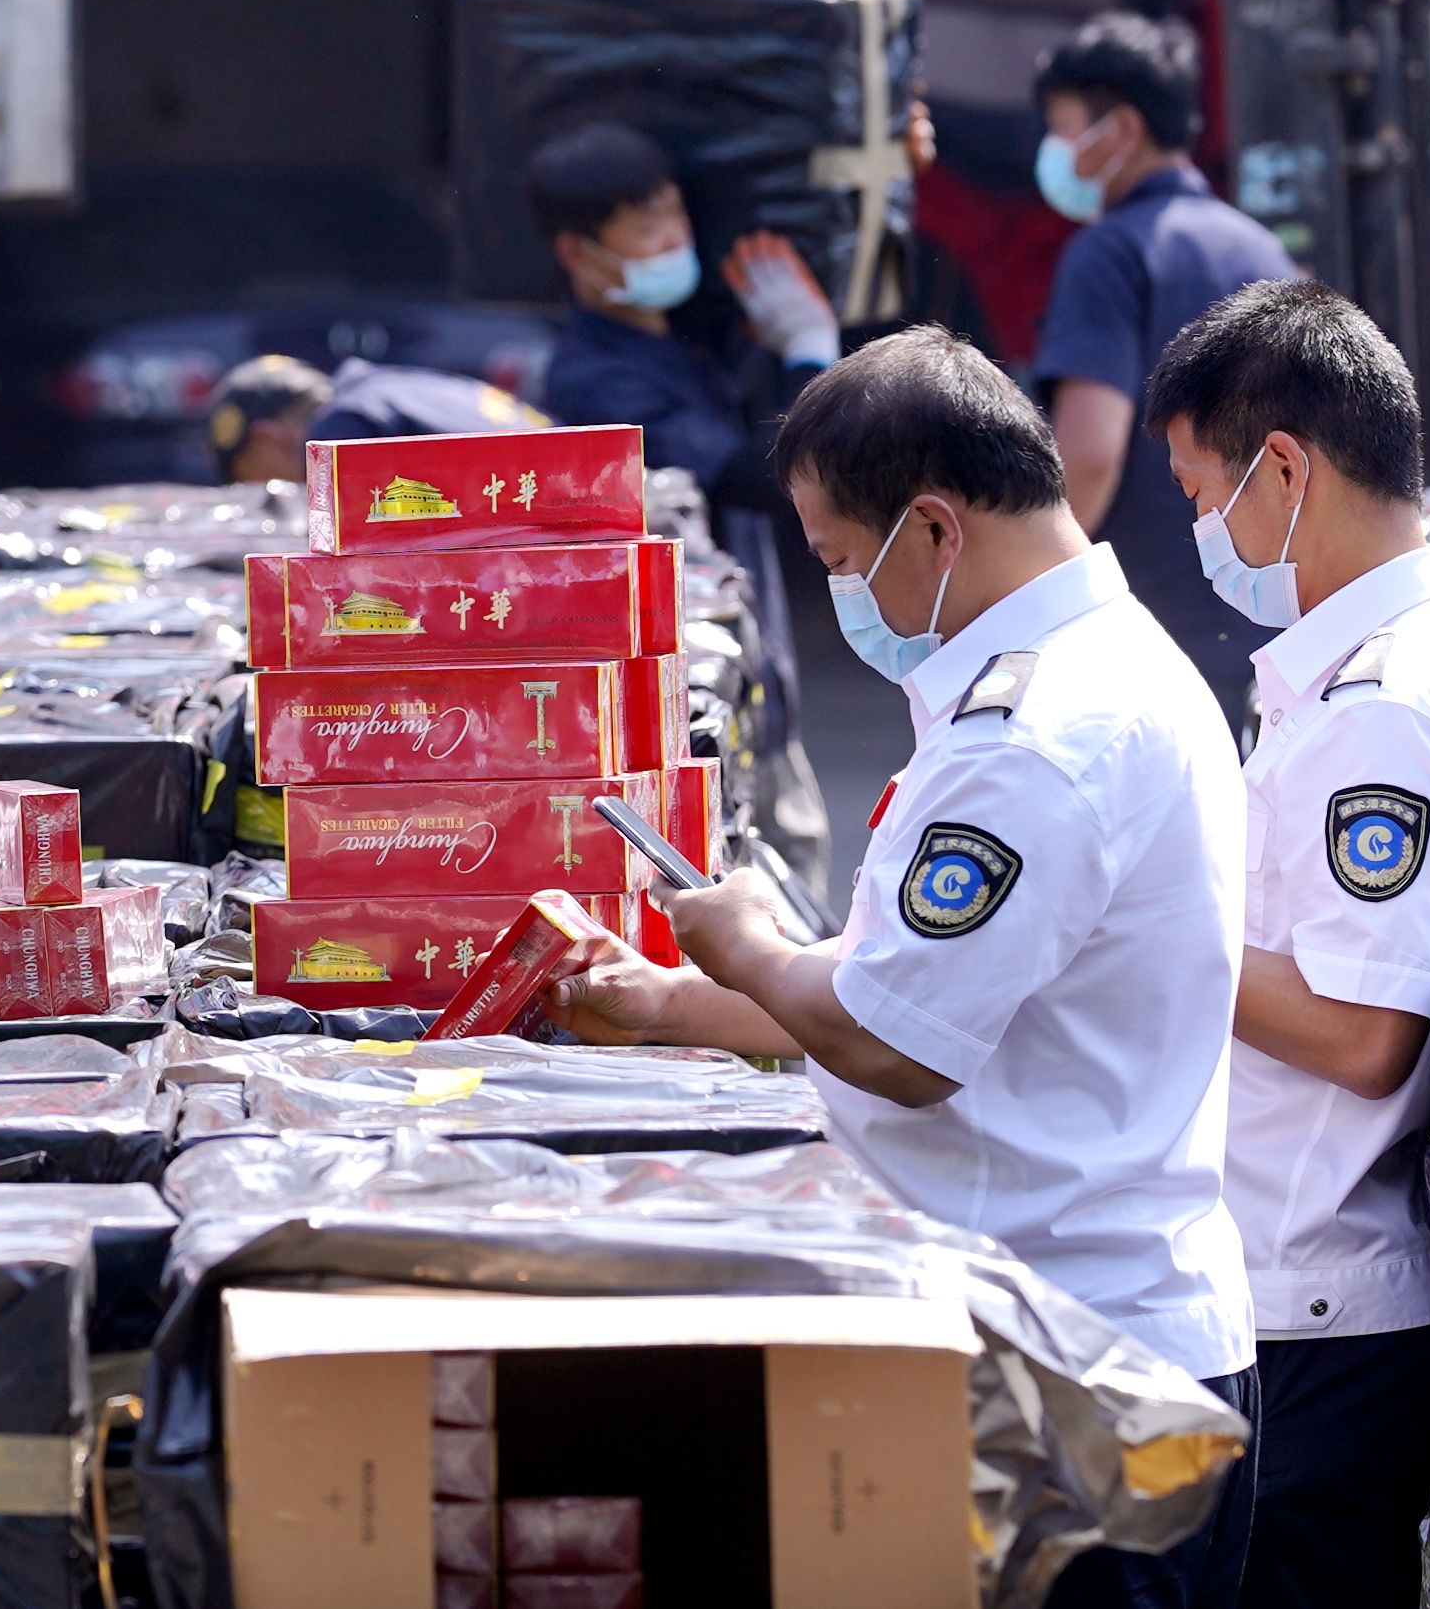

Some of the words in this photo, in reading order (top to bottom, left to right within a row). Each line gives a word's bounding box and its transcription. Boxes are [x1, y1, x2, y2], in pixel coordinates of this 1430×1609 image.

[482, 469, 538, 513] 中華
[449, 587, 513, 631] 中華
[291, 704, 372, 718] CIGARETTES
[390, 702, 436, 715] FILTER
[310, 703, 470, 759] Chunghwa
[320, 819, 401, 833] CIGARETTES
[418, 816, 464, 829] FILTER
[36, 813, 53, 885] CHUNGHWA
[339, 816, 497, 874] Chunghwa
[21, 928, 39, 1000] CHUNGHWA
[75, 926, 95, 998] CHUNGHWA
